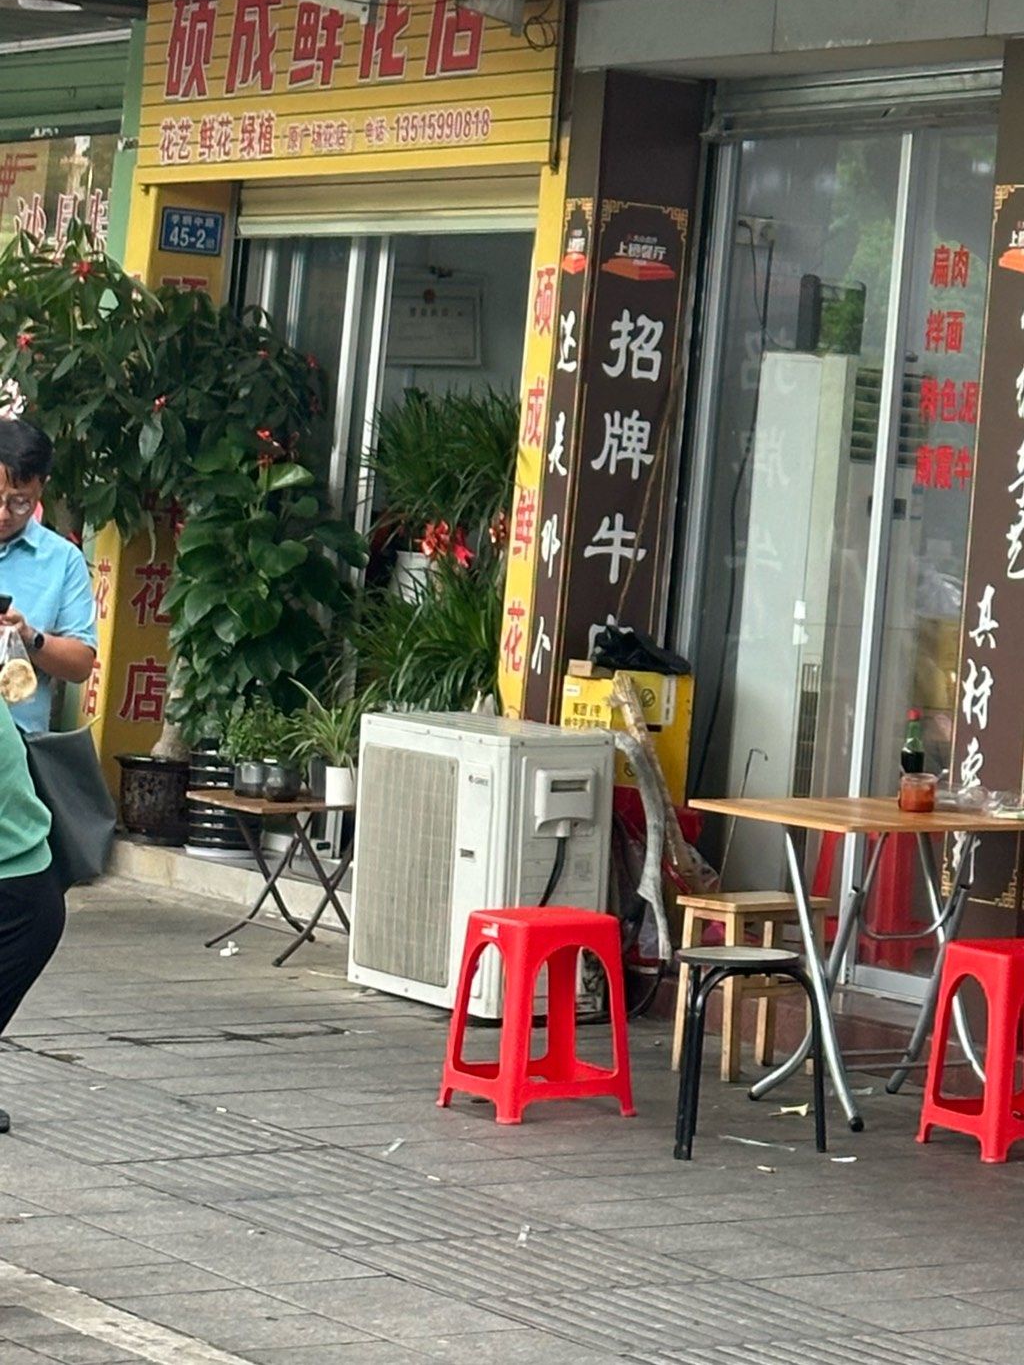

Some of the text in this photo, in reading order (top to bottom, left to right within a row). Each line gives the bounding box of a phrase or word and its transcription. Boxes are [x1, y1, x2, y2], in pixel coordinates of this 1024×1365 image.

[159, 117, 194, 164] 花艺
[198, 114, 232, 162] 鲜花
[393, 107, 493, 144] 13515990818
[169, 226, 206, 249] 45-2
[930, 245, 970, 288] 扁肉
